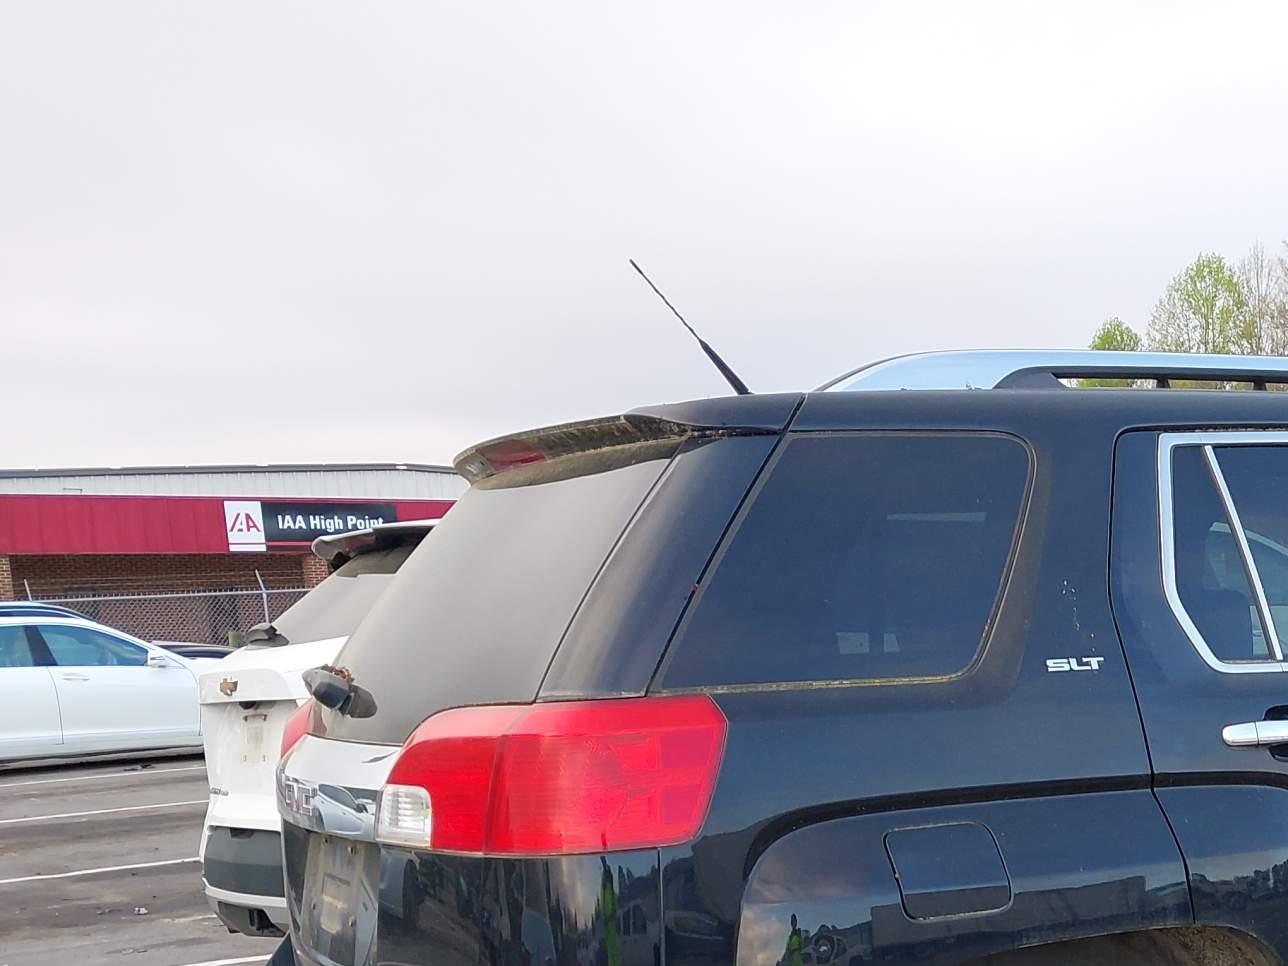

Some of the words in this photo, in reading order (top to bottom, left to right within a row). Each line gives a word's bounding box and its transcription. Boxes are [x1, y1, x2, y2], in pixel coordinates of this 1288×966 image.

[277, 515, 307, 530] IAA
[310, 515, 347, 533] High
[1046, 656, 1105, 672] SLT
